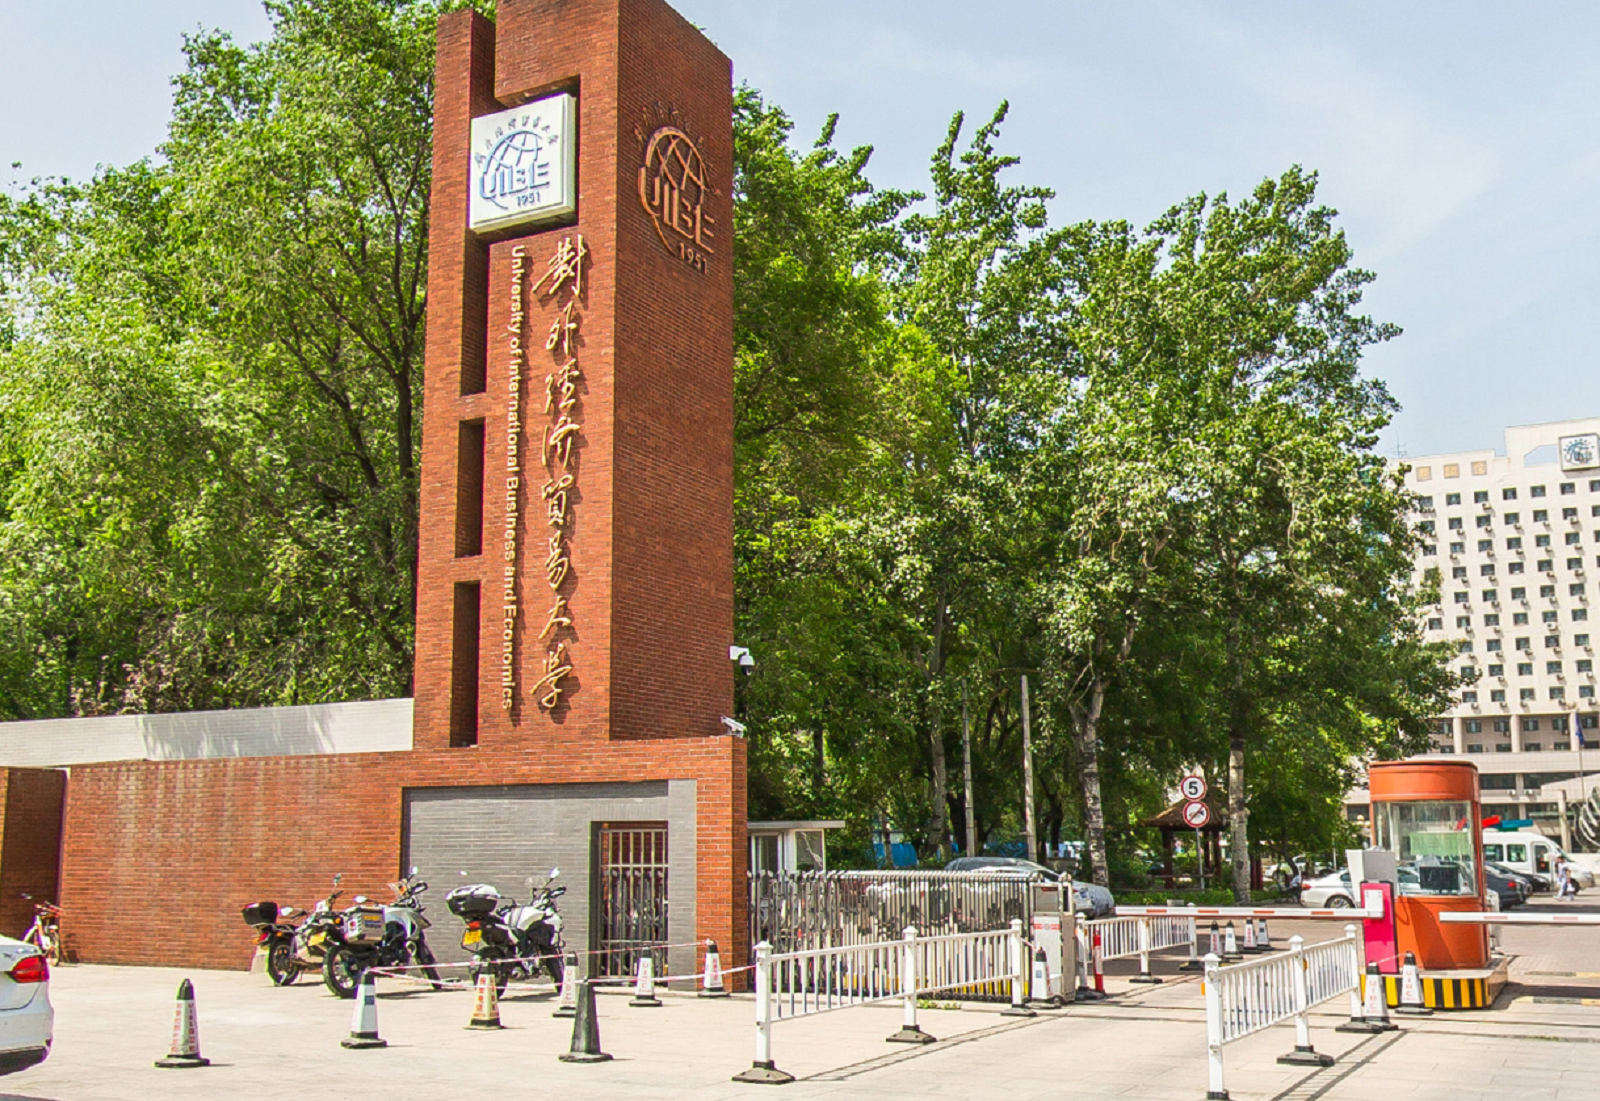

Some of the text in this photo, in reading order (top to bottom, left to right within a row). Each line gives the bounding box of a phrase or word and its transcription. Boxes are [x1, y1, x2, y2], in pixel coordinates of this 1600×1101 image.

[516, 191, 541, 207] 1951
[680, 242, 707, 274] 1951
[501, 244, 525, 711] University of International Business and Economics
[1188, 780, 1198, 796] 5
